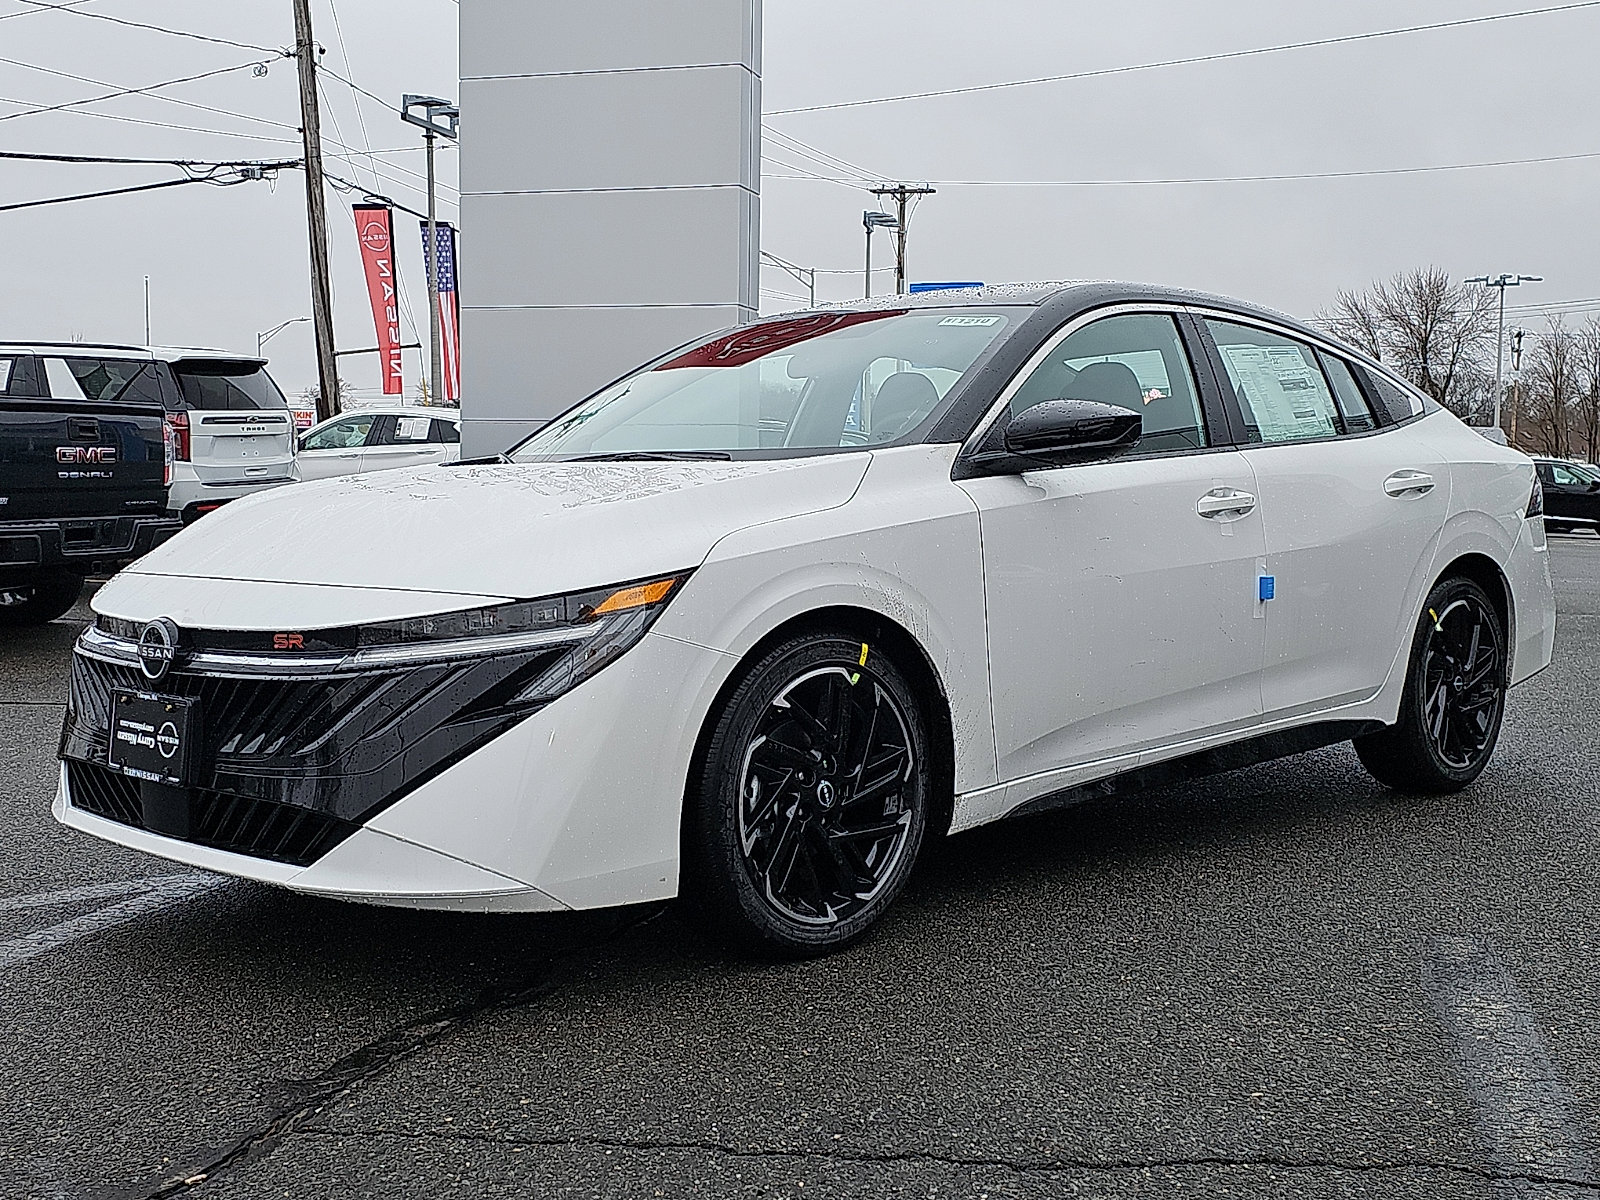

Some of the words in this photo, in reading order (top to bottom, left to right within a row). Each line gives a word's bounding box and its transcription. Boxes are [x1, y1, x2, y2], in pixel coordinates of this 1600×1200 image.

[56, 446, 116, 464] GMC
[273, 633, 304, 649] SR
[137, 732, 155, 749] Curry
[156, 734, 180, 745] NISSAN
